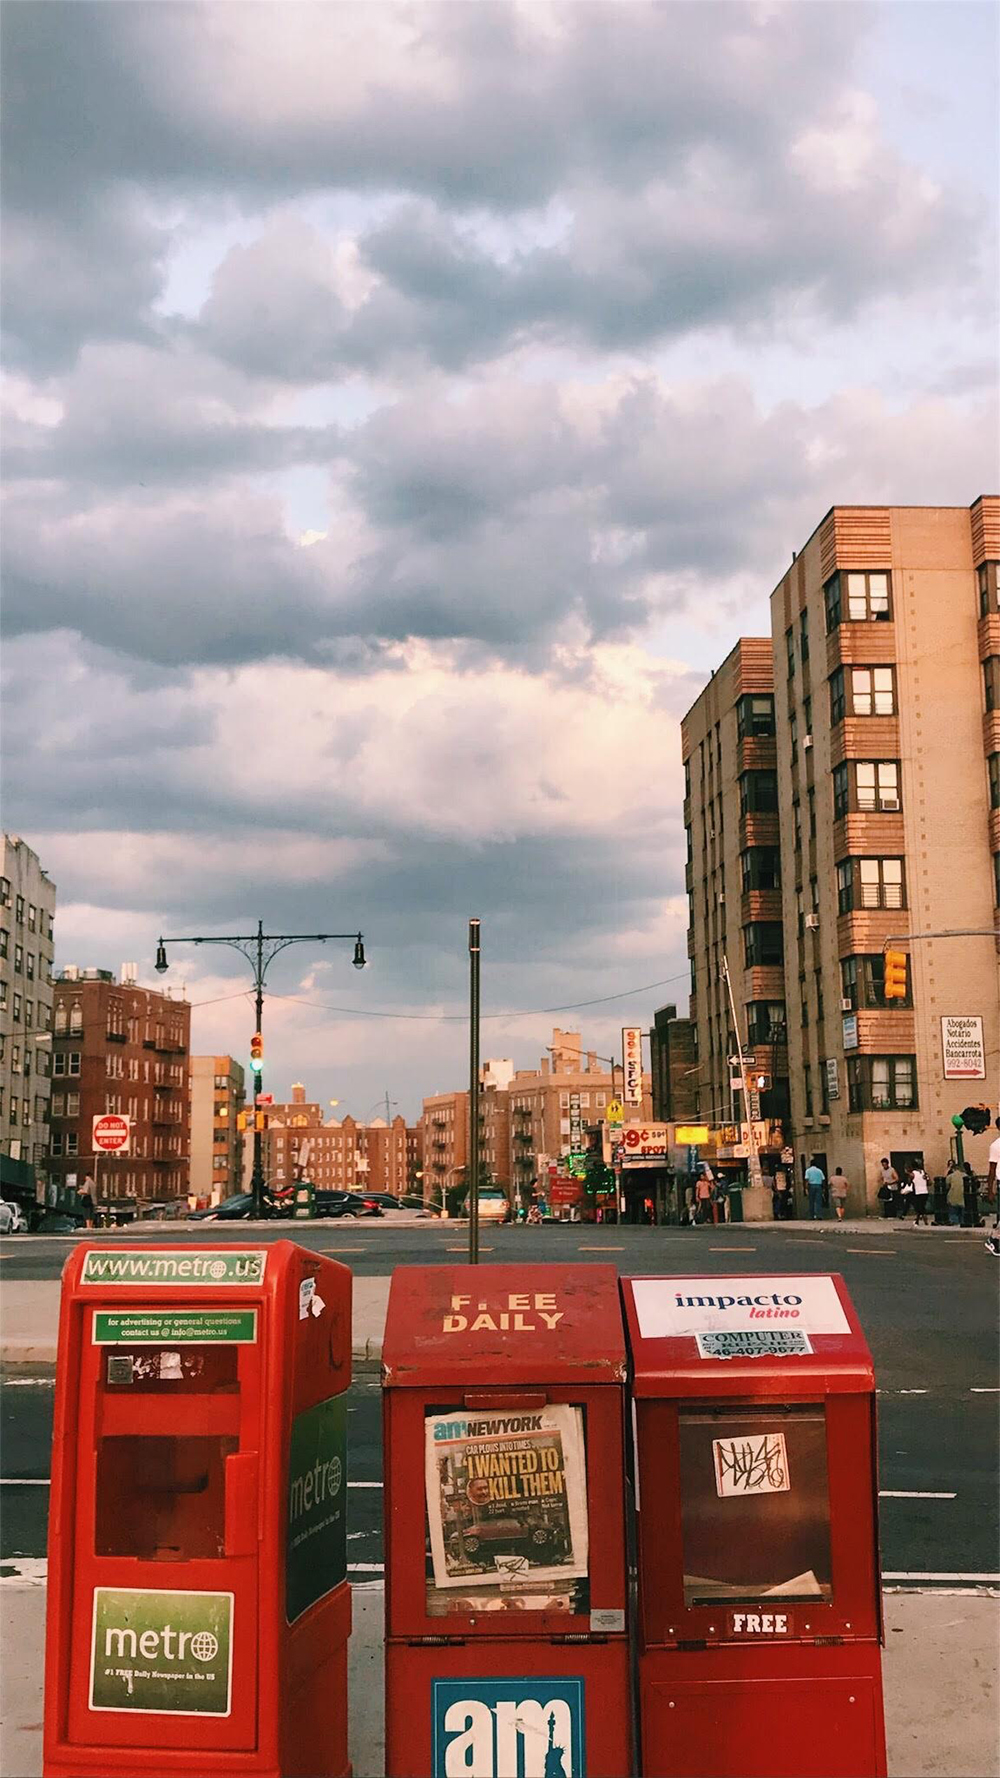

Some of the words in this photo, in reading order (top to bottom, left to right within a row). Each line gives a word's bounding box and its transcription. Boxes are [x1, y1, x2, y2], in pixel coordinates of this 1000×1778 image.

[947, 1019, 977, 1030] Abogados
[947, 1029, 971, 1037] Notario
[946, 1040, 981, 1048] Accidentes
[946, 1049, 982, 1058] Bancarrota
[99, 1137, 123, 1145] ENTER
[641, 1145, 666, 1154] SPOT
[88, 1257, 263, 1279] www.metro.us
[451, 1294, 557, 1311] FEE
[674, 1293, 803, 1310] impacto
[749, 1307, 800, 1319] latino
[108, 1318, 119, 1326] for
[120, 1318, 162, 1327] advertising
[173, 1317, 203, 1327] general
[204, 1317, 242, 1327] questions
[443, 1313, 564, 1332] DAILY
[161, 1327, 170, 1338] @
[171, 1327, 228, 1339] info@metro.us
[703, 1331, 803, 1342] COMPUTER
[466, 1445, 478, 1455] CAR
[479, 1443, 499, 1454] PLOWS
[500, 1441, 513, 1451] INTO
[513, 1440, 532, 1450] TIMES
[476, 1449, 538, 1478] WANTED
[537, 1447, 559, 1472] TO
[289, 1456, 342, 1524] metro
[488, 1476, 522, 1500] KILL
[733, 1613, 788, 1633] FREE
[105, 1624, 219, 1662] metro
[115, 1669, 133, 1677] FREE
[134, 1670, 151, 1679] Daily
[151, 1670, 186, 1680] Newspaper
[186, 1672, 193, 1680] in
[206, 1673, 216, 1681] US
[444, 1699, 573, 1778] am
